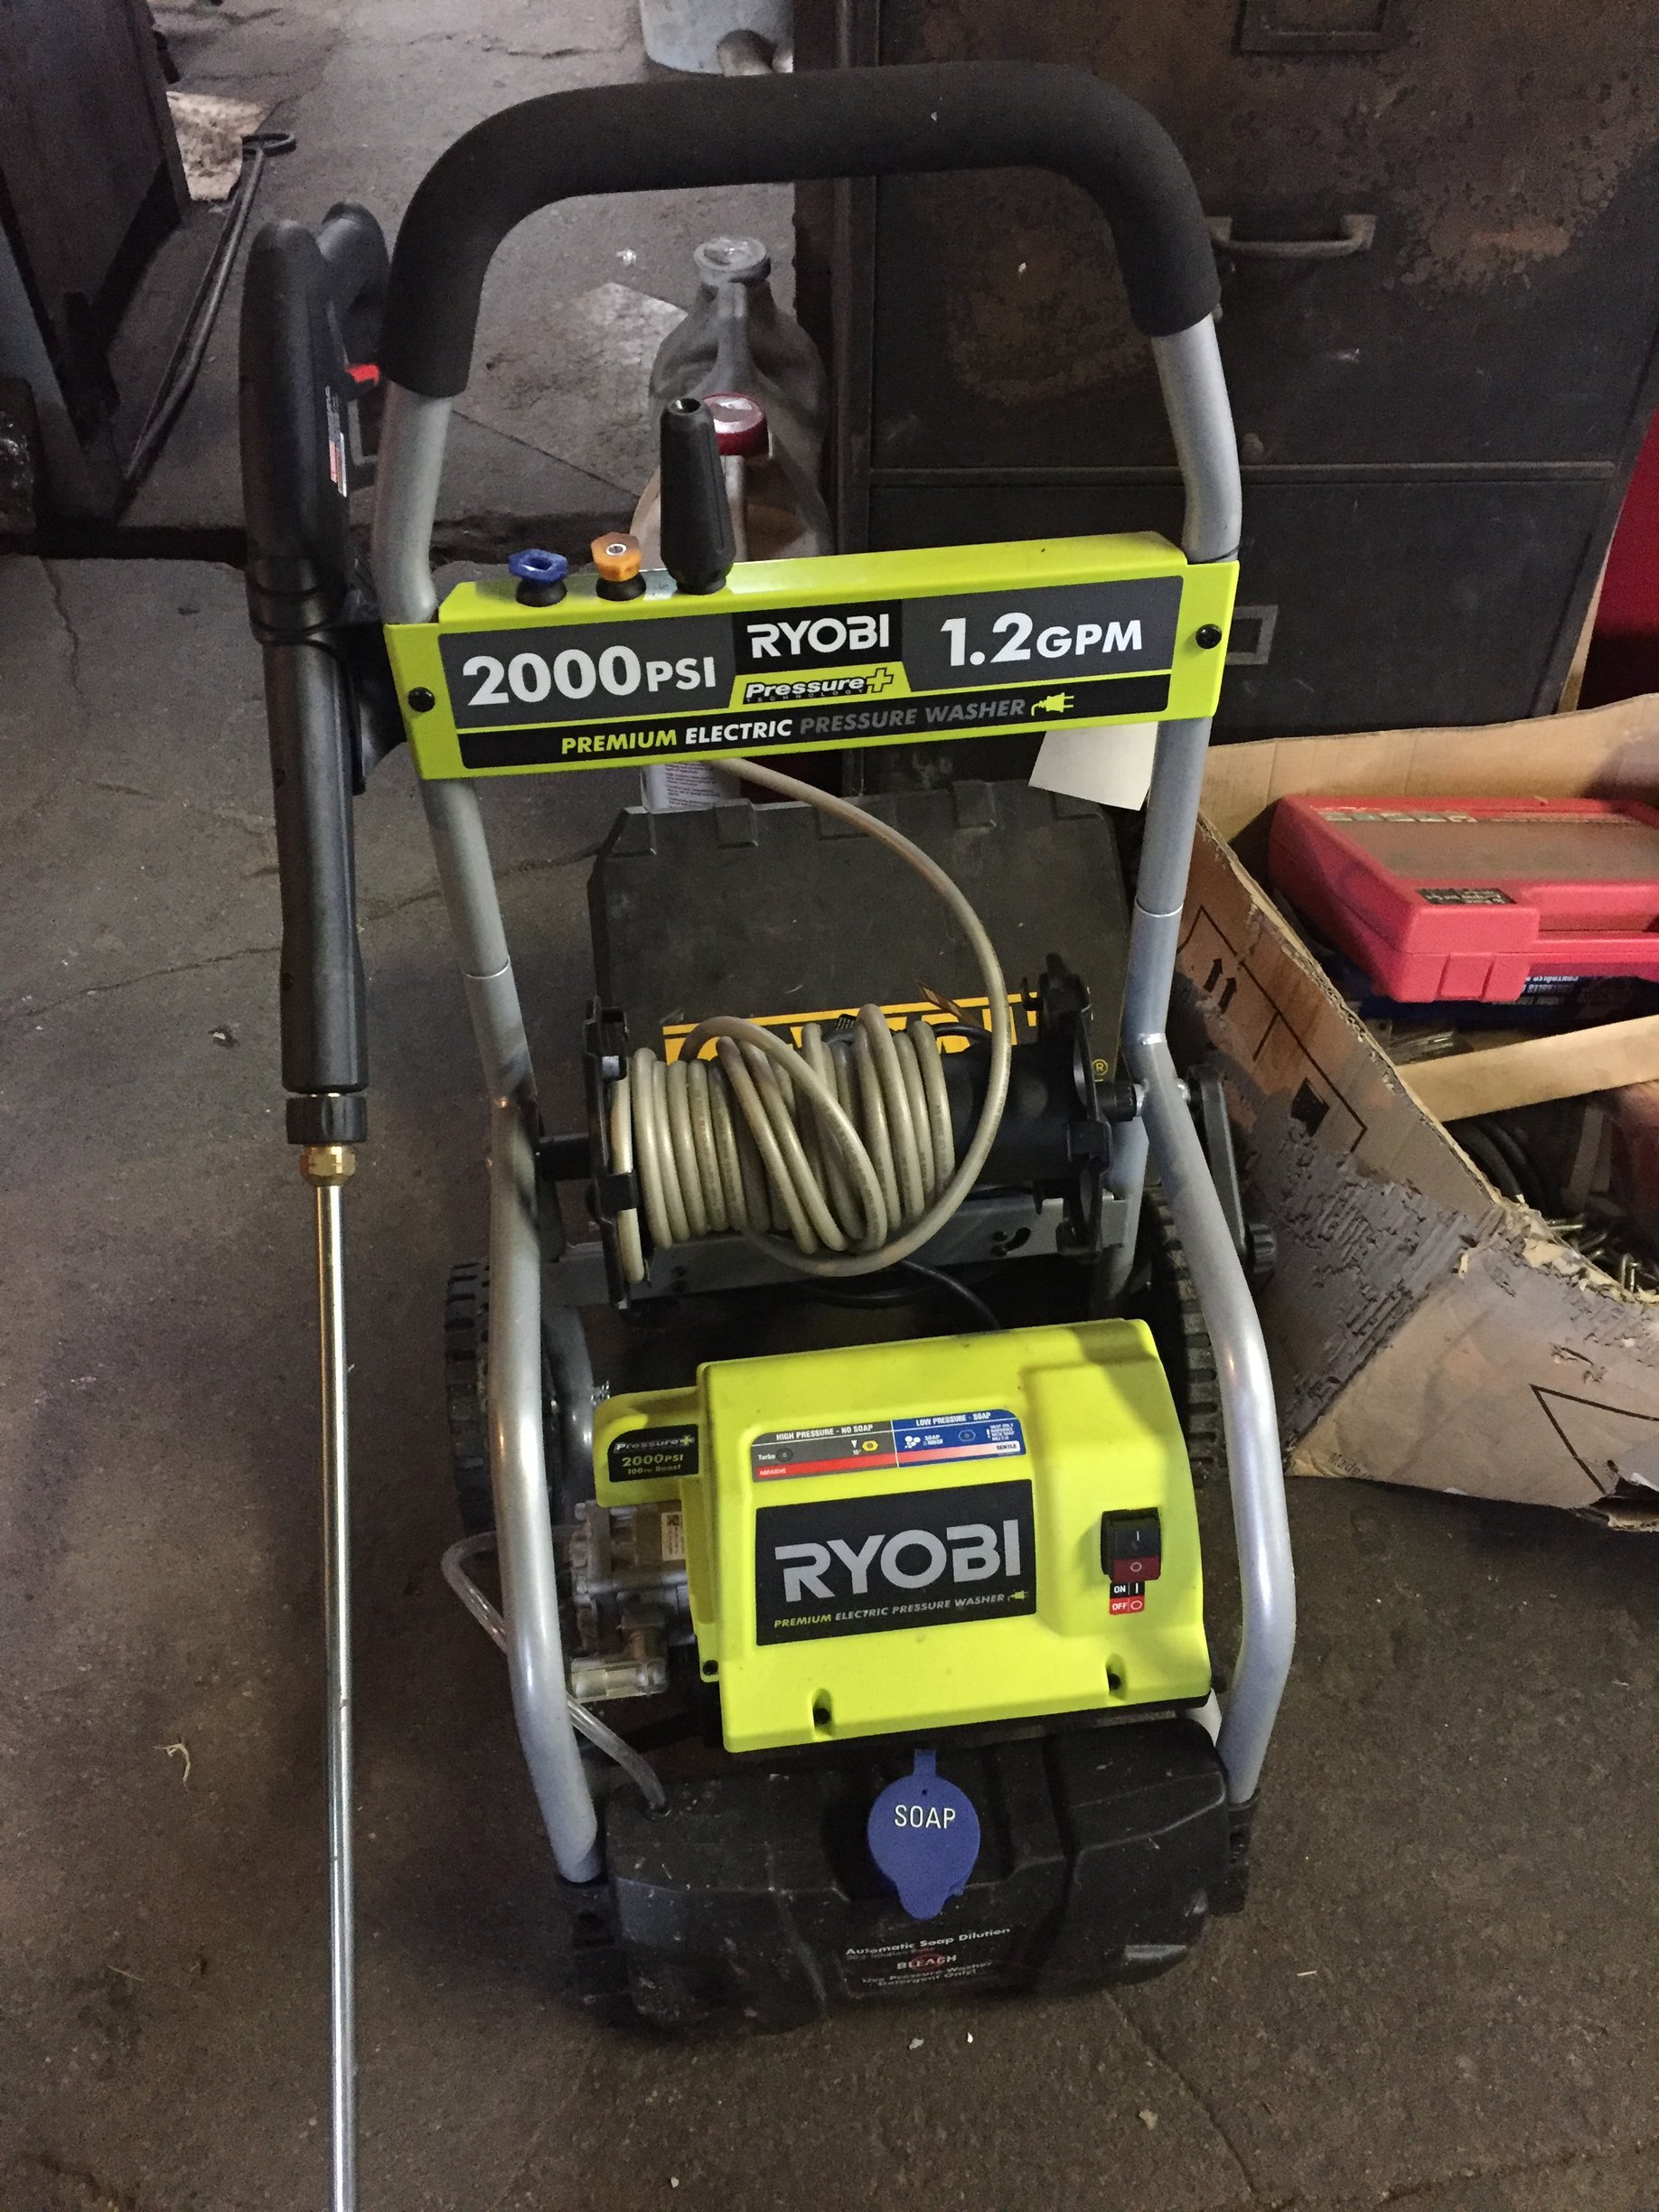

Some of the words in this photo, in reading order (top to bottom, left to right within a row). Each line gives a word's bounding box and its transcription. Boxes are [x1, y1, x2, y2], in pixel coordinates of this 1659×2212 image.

[747, 614, 889, 658] RYOBI
[561, 730, 677, 754] PREMIUM
[685, 719, 792, 745] ELECTRIC
[800, 708, 917, 735] PRESSURE
[925, 698, 1026, 723] WASHER
[933, 1414, 967, 1425] PRESSURE
[972, 1412, 991, 1420] SOAP
[776, 1432, 794, 1441] HIGH
[796, 1429, 834, 1439] PRESSURE
[841, 1426, 852, 1434] NO
[853, 1424, 874, 1433] SOAP
[774, 1519, 1021, 1603] RYOBI
[1113, 1585, 1126, 1594] ON
[774, 1613, 832, 1628] PREMIUM
[835, 1607, 889, 1622] ELECTRIC
[892, 1600, 951, 1615] PRESSURE
[954, 1593, 1005, 1608] WASHER
[1111, 1602, 1128, 1611] OFF
[895, 1804, 956, 1829] SOAP
[845, 1942, 916, 1955] Automatic
[920, 1937, 955, 1947] Soap
[958, 1928, 1011, 1942] Dilution
[896, 1954, 957, 1970] BLEACH
